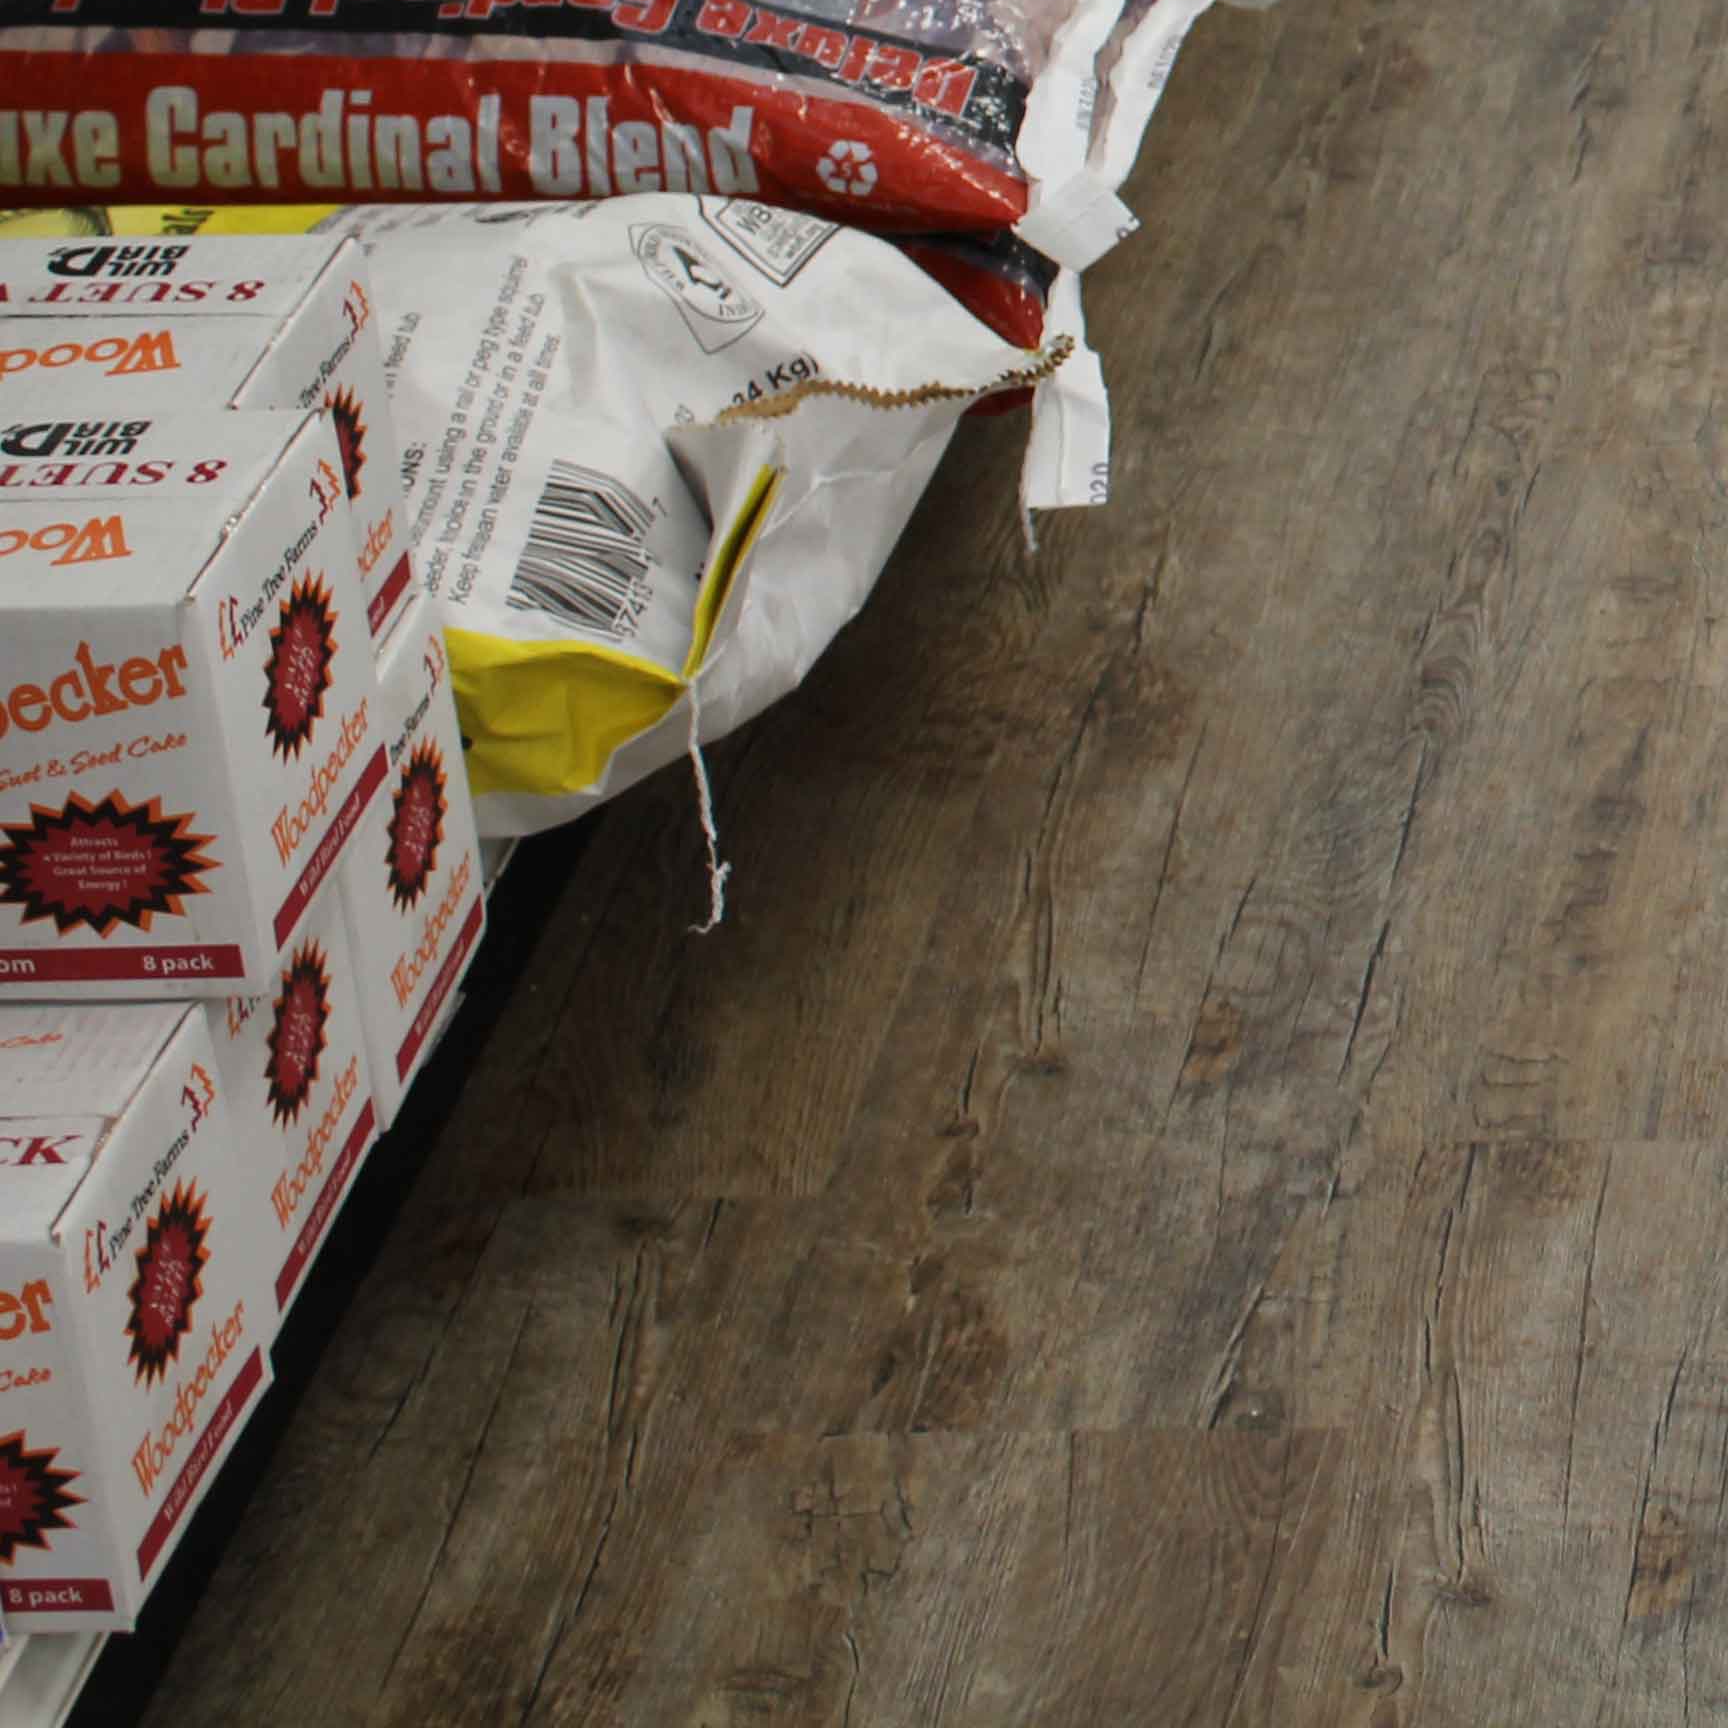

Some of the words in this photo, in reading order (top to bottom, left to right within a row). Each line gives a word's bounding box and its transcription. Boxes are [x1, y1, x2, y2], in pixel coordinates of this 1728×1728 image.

[145, 84, 503, 195] Cardinal
[525, 92, 760, 198] Blend
[29, 281, 214, 303] SUET
[227, 281, 266, 302] 8
[765, 353, 821, 391] Kg)
[186, 459, 229, 485] 8
[461, 443, 488, 476] the
[259, 562, 288, 601] Tree
[284, 519, 318, 570] Farms
[445, 559, 481, 607] Keep
[71, 742, 124, 776] Seed
[128, 732, 188, 758] Cake
[270, 697, 371, 867] Woodpecker
[53, 850, 96, 864] Variety
[70, 835, 119, 849] Attracts
[53, 865, 87, 878] Great
[89, 863, 131, 877] Source
[143, 955, 158, 971] 8
[162, 953, 215, 975] pack
[271, 1056, 358, 1233] Woodpecker
[127, 1177, 160, 1222] Tree
[152, 1130, 191, 1183] Farms
[130, 1300, 245, 1496] Woodpecker
[8, 1586, 24, 1605] 8
[29, 1586, 85, 1610] pack
